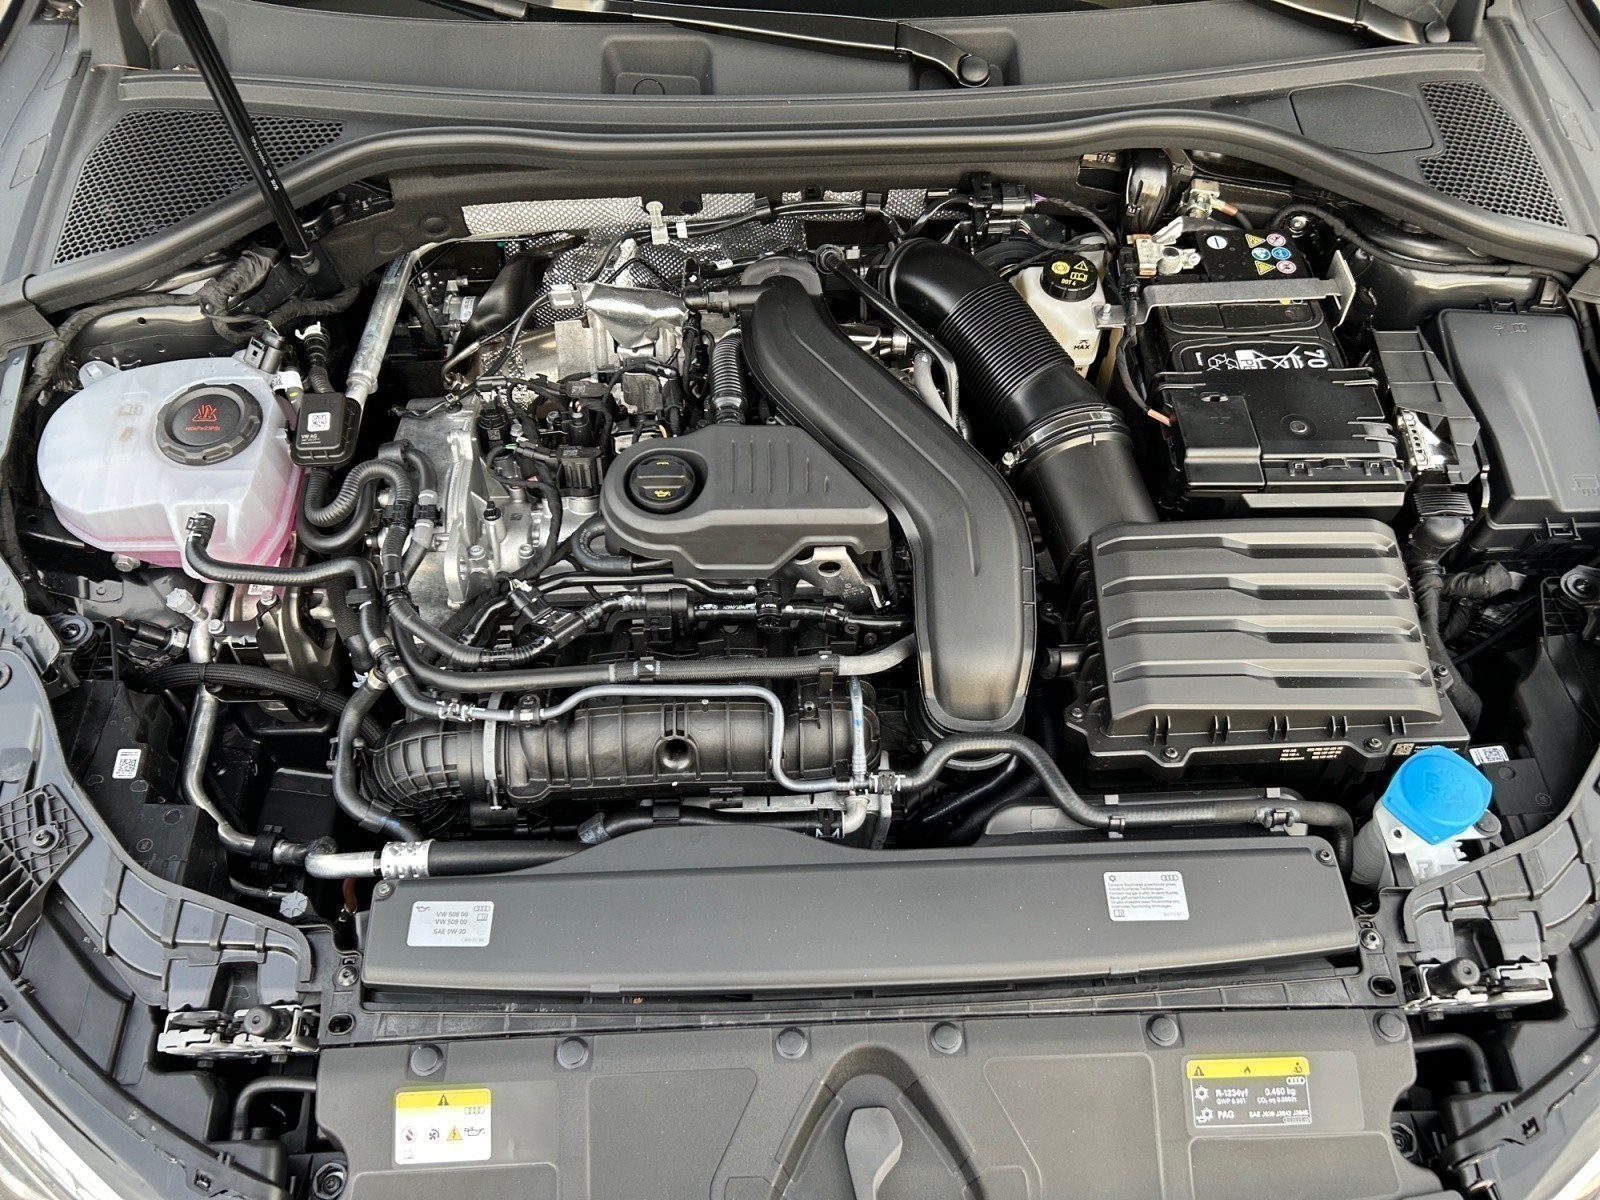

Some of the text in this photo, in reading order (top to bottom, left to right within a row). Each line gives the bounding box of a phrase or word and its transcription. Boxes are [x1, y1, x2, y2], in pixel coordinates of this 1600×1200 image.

[1303, 349, 1329, 369] 70
[1215, 1088, 1249, 1098] R-1234yf
[1286, 1086, 1296, 1097] kg
[1216, 1097, 1231, 1105] GWP
[1217, 1110, 1235, 1119] PAG
[1249, 1110, 1261, 1118] SAE
